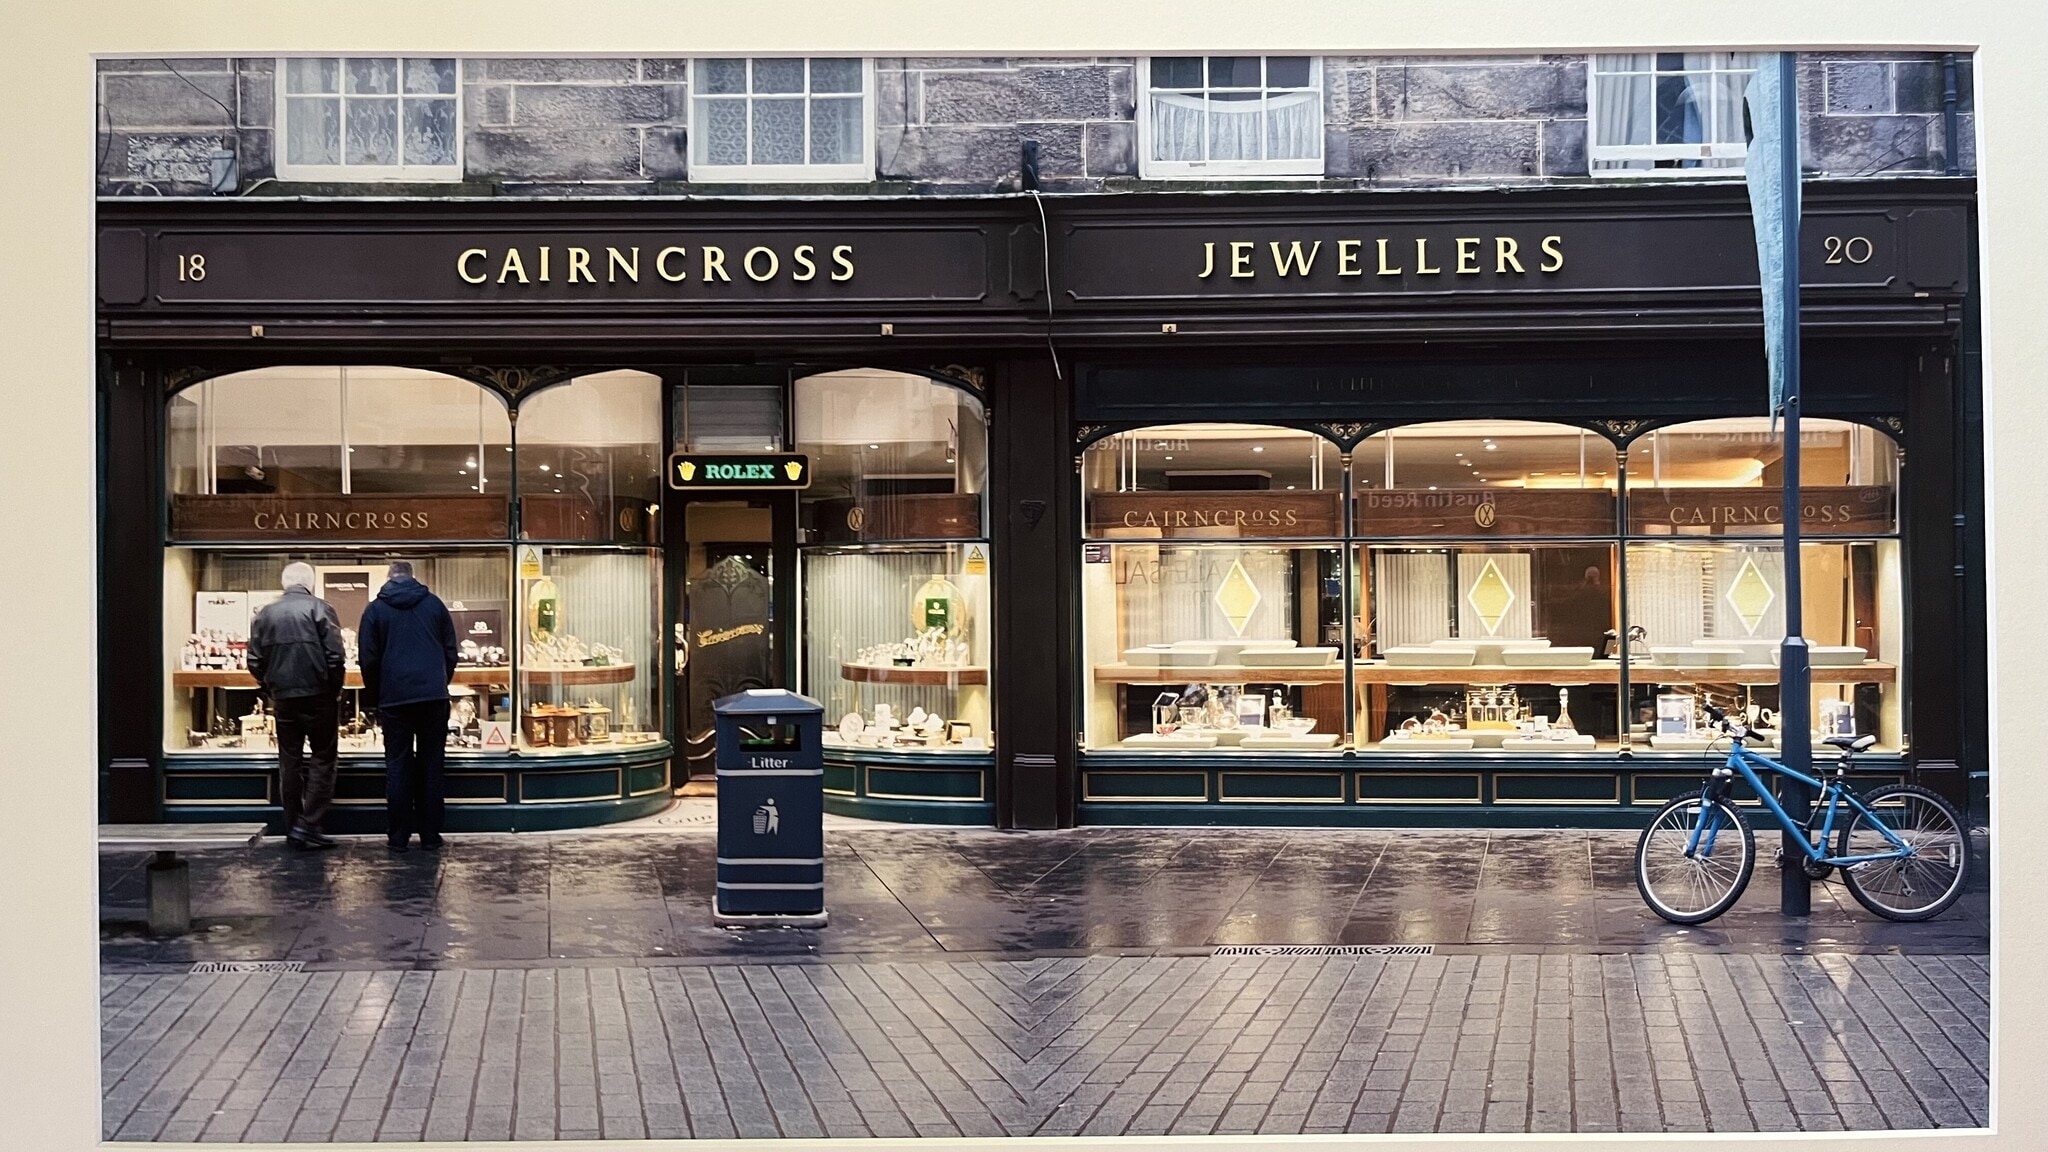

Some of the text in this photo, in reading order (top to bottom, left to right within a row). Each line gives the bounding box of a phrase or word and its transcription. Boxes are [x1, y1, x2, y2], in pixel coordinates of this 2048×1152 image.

[1197, 235, 1565, 278] JEWELLERS
[1824, 236, 1873, 265] 20
[178, 254, 206, 282] 18
[457, 245, 855, 284] CAIRNCROSS
[705, 464, 775, 480] ROLEX
[253, 512, 430, 530] CAIRNCROSS
[1124, 509, 1298, 528] CAIRNCROSS
[1670, 505, 1852, 526] CAIRNCOSS
[750, 757, 789, 769] Litter
